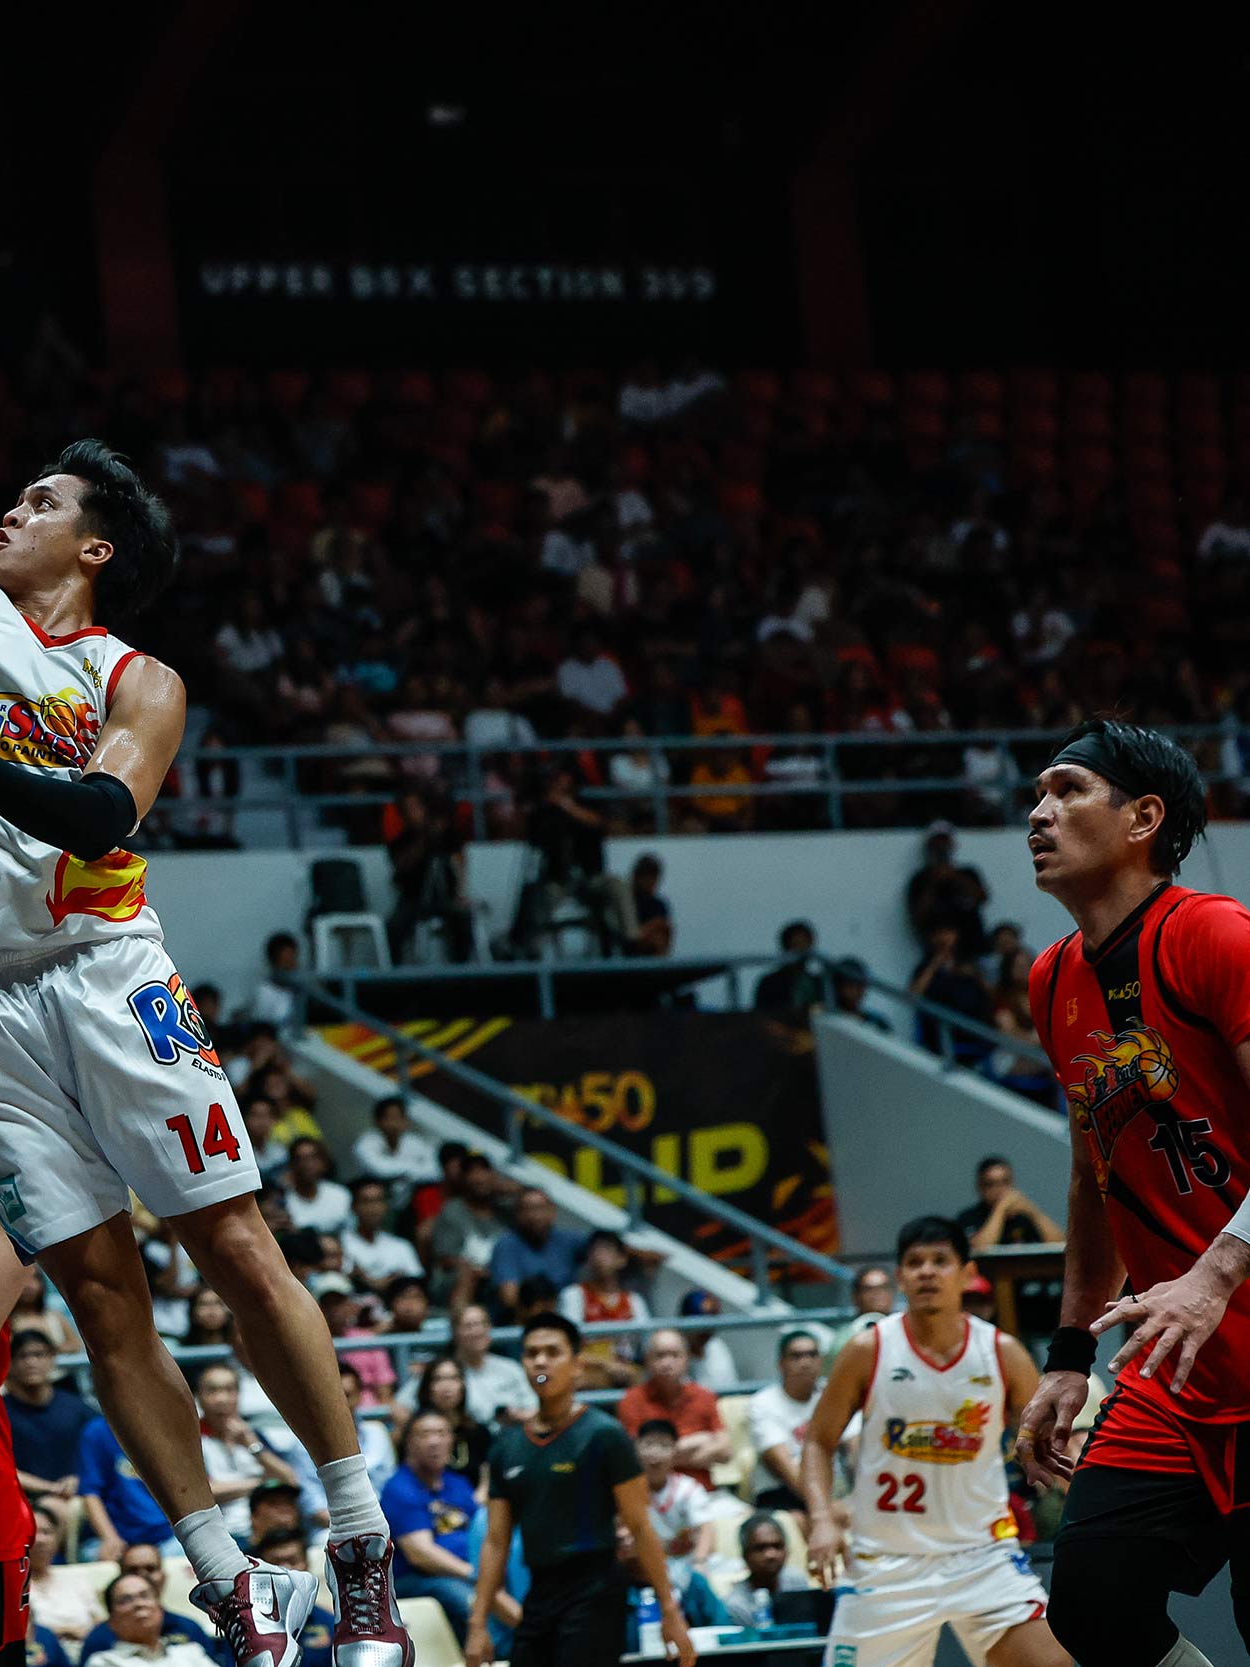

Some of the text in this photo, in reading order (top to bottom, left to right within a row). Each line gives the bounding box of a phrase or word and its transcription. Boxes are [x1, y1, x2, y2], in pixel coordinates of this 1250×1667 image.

[201, 264, 331, 298] UPPER
[455, 265, 625, 300] SECTION
[191, 1058, 223, 1081] ELASTO
[165, 1103, 241, 1175] 14
[1149, 1118, 1231, 1195] 15
[876, 1472, 926, 1514] 22
